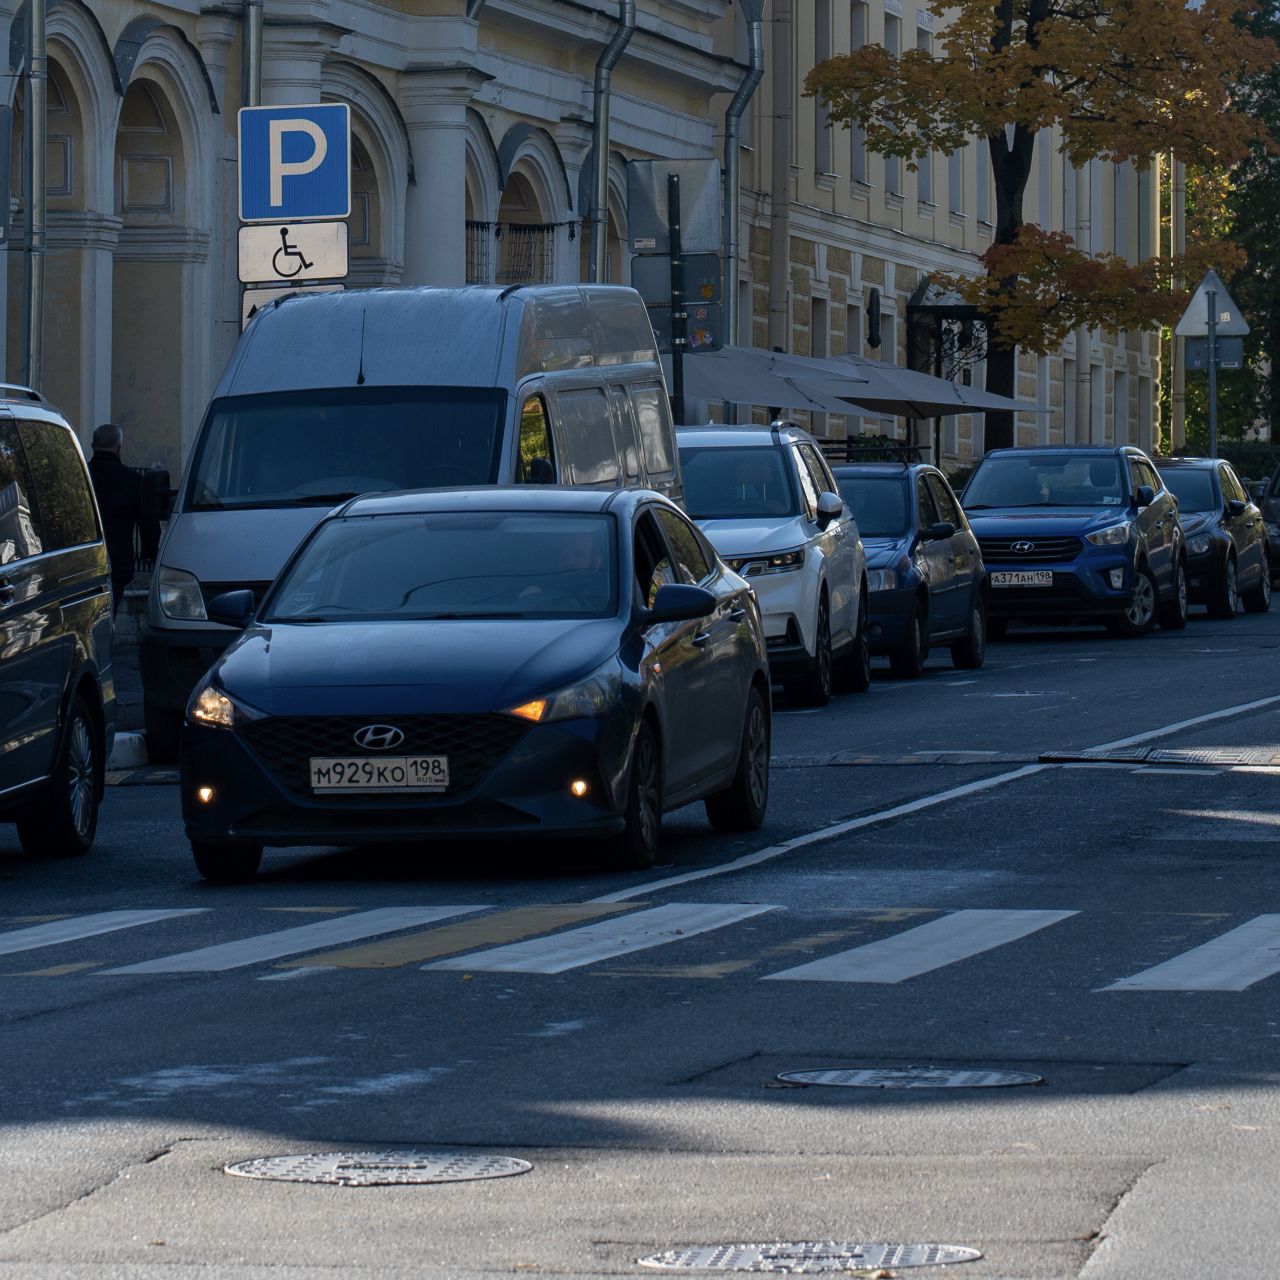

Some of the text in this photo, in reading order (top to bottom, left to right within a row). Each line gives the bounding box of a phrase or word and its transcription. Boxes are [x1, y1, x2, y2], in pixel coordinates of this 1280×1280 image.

[269, 119, 327, 207] P
[993, 572, 1033, 584] А371АН
[316, 759, 441, 784] М929КО 198
